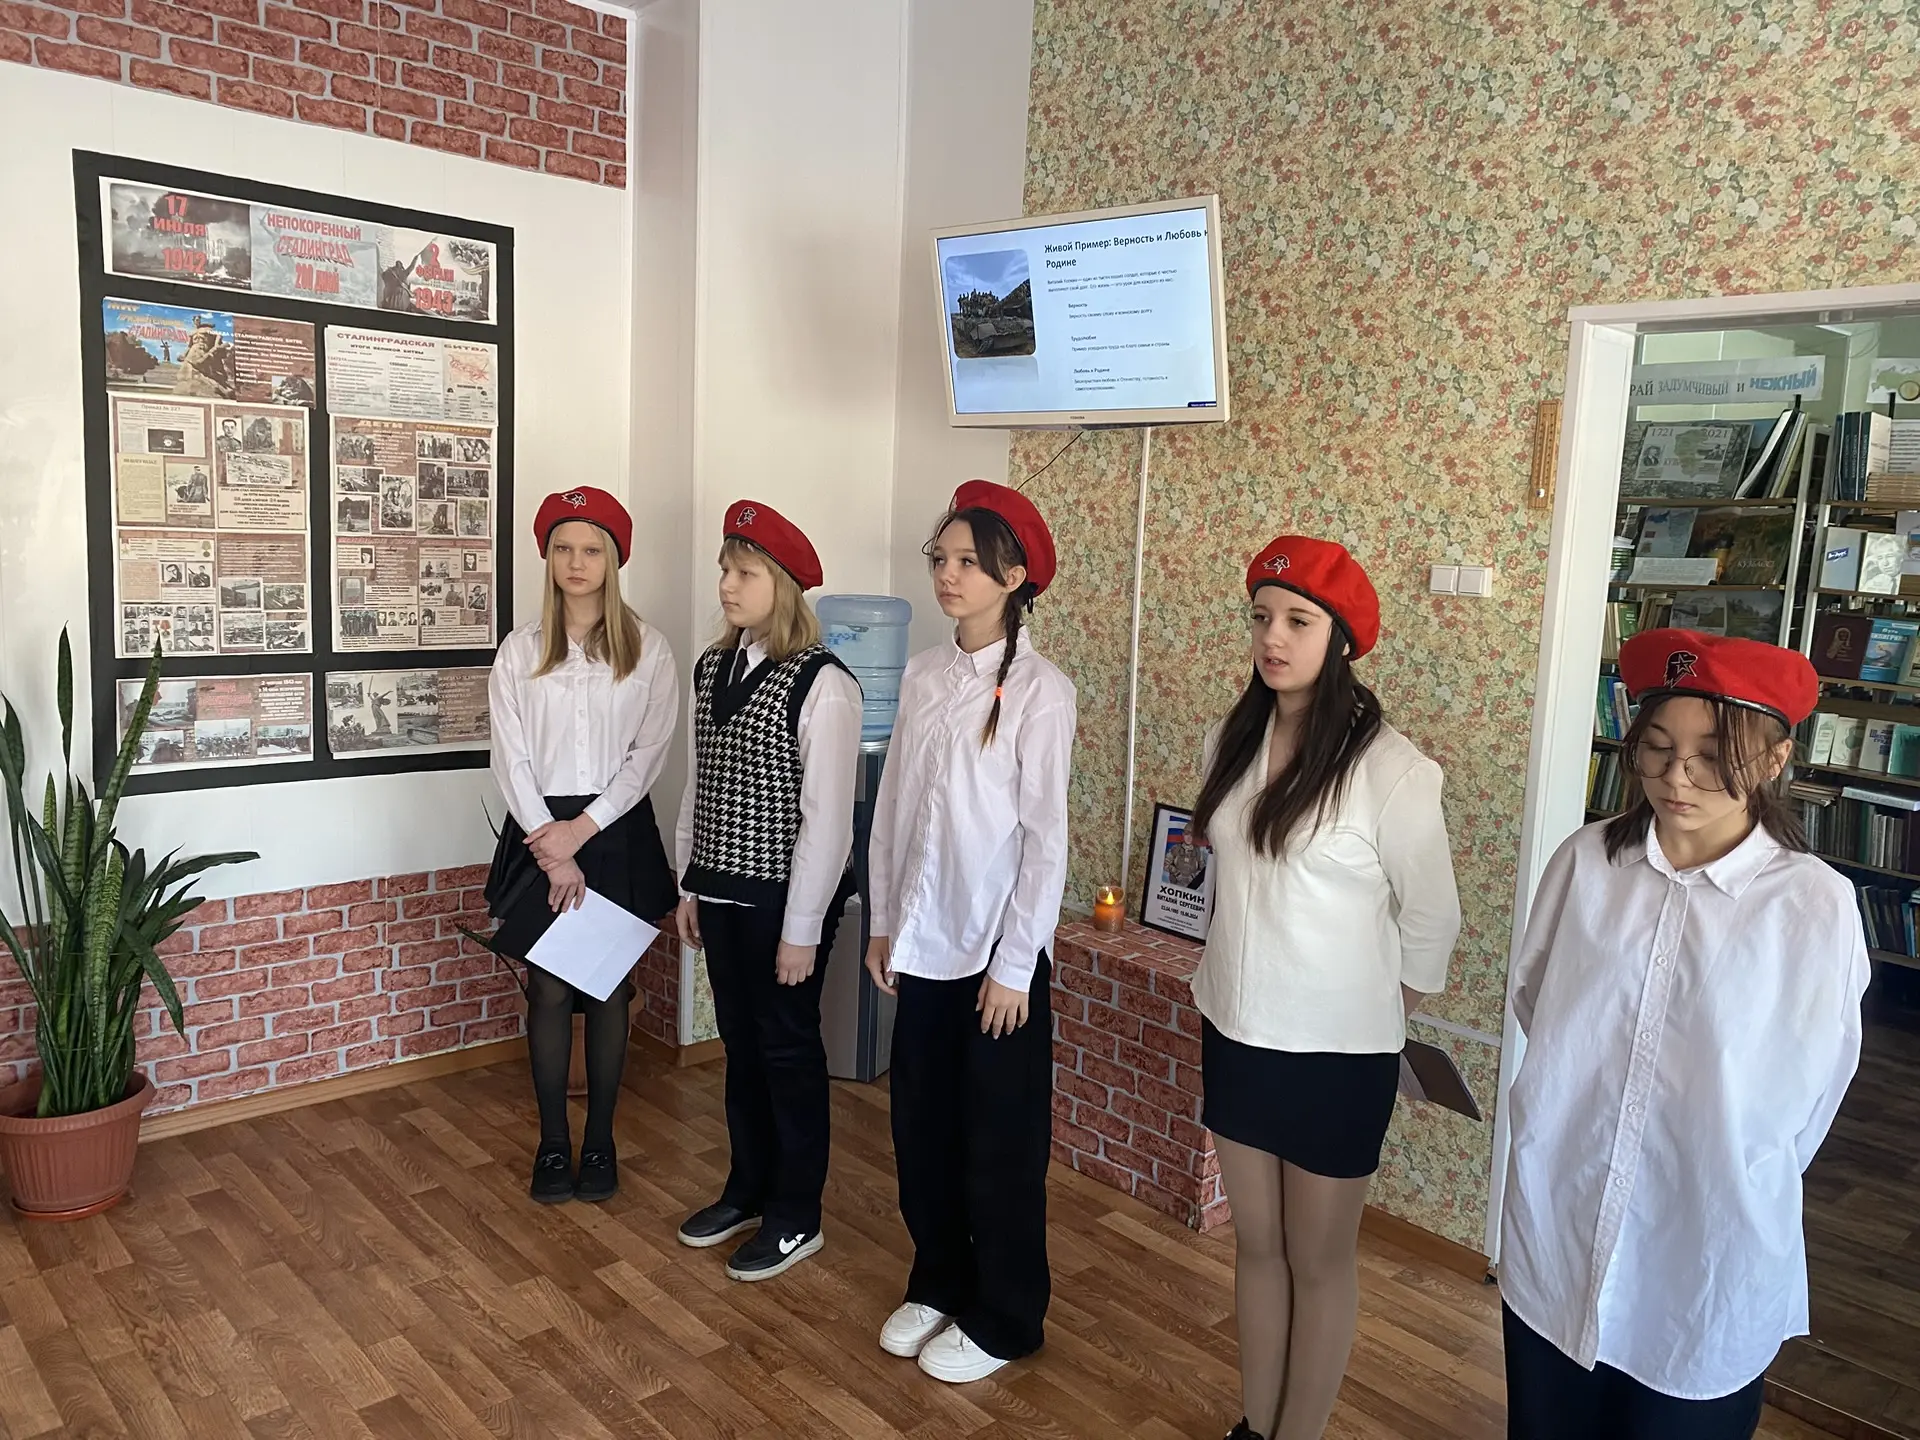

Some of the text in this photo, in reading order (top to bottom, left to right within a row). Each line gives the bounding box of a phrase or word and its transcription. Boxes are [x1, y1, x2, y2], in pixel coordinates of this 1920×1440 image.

[165, 195, 188, 217] 17
[267, 213, 362, 241] НЕПОКОРЕННЫЙ
[276, 235, 354, 267] СТАЛИНГРАД
[1044, 241, 1073, 253] Живой
[1075, 239, 1112, 251] Пример:
[1113, 236, 1155, 247] Верность
[1165, 229, 1202, 241] Любовь
[162, 247, 207, 274] 1942
[429, 243, 440, 266] 2
[1046, 259, 1077, 269] Родине
[295, 262, 314, 290] 200
[414, 287, 455, 316] 1943
[337, 332, 488, 353] СТАЛИНГРАДСКАЯ БИТВА
[1658, 379, 1729, 397] ЗАДУМЧИВЫЙ
[1749, 363, 1817, 392] НЕЖНЫЙ
[1159, 885, 1205, 905] ХОПКИН
[1179, 900, 1205, 913] СЕРГЕЕВИЧ
